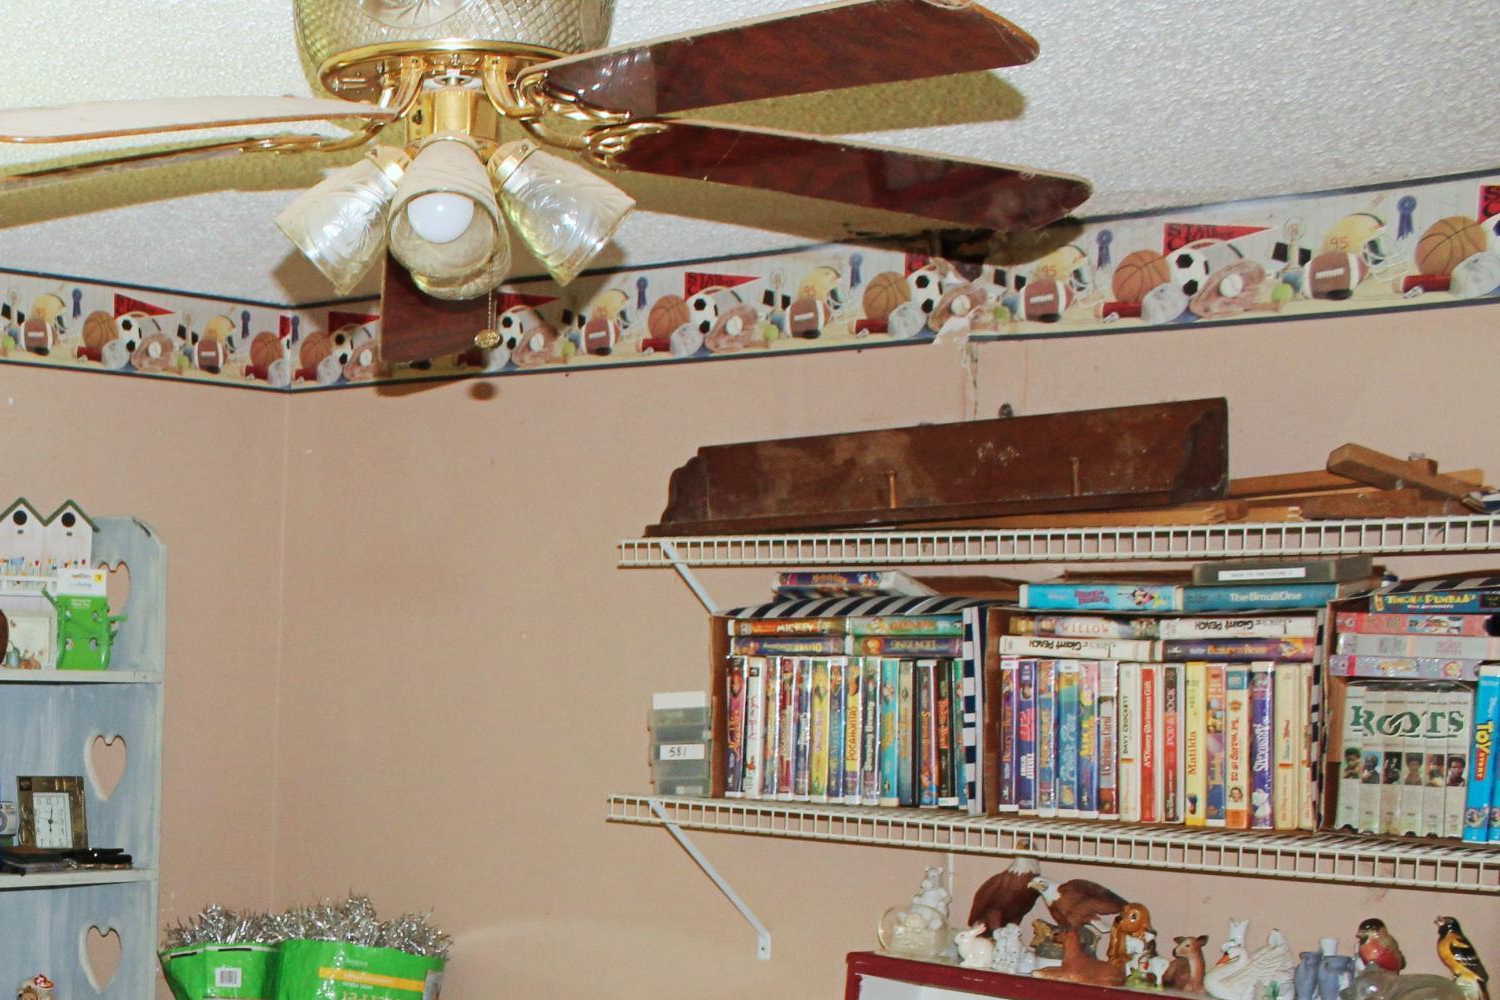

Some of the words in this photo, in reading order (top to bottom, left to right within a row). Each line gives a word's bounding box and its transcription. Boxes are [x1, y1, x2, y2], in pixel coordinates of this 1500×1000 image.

[1061, 622, 1110, 633] WILLOW
[846, 705, 858, 761] POCAHONTAS
[1350, 705, 1464, 739] ROOTS
[1475, 719, 1495, 756] TOY
[1187, 730, 1197, 775] Matilda
